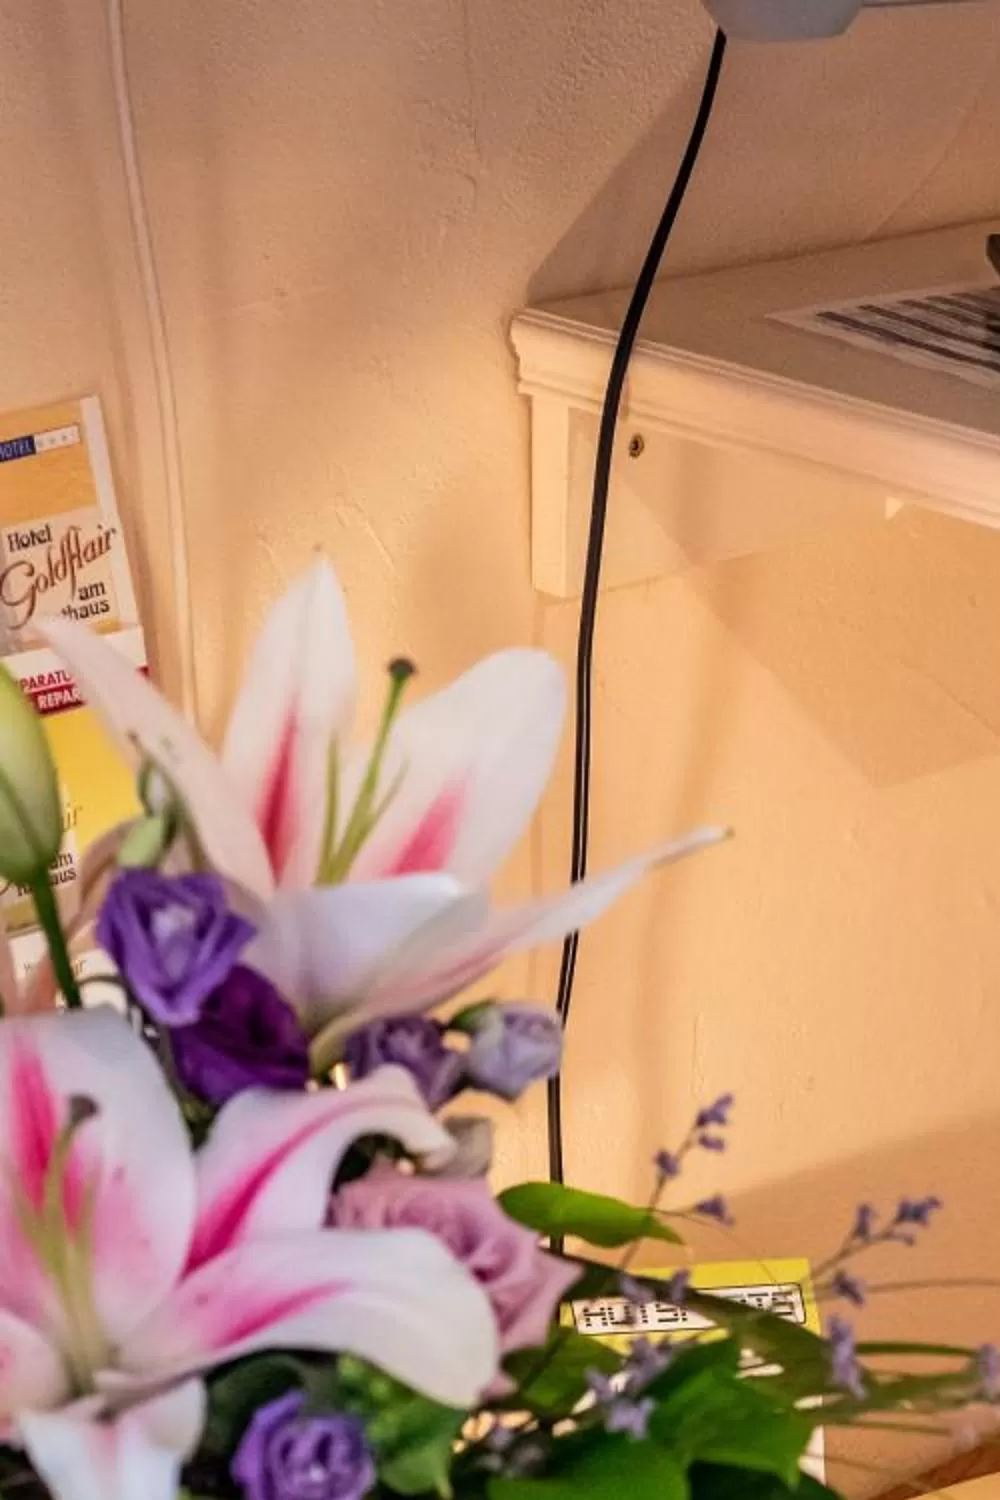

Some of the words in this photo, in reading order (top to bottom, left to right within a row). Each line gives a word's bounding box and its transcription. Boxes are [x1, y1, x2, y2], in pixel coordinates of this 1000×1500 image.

[7, 523, 53, 553] Hotel
[0, 524, 117, 631] Goldflair
[78, 581, 107, 601] am
